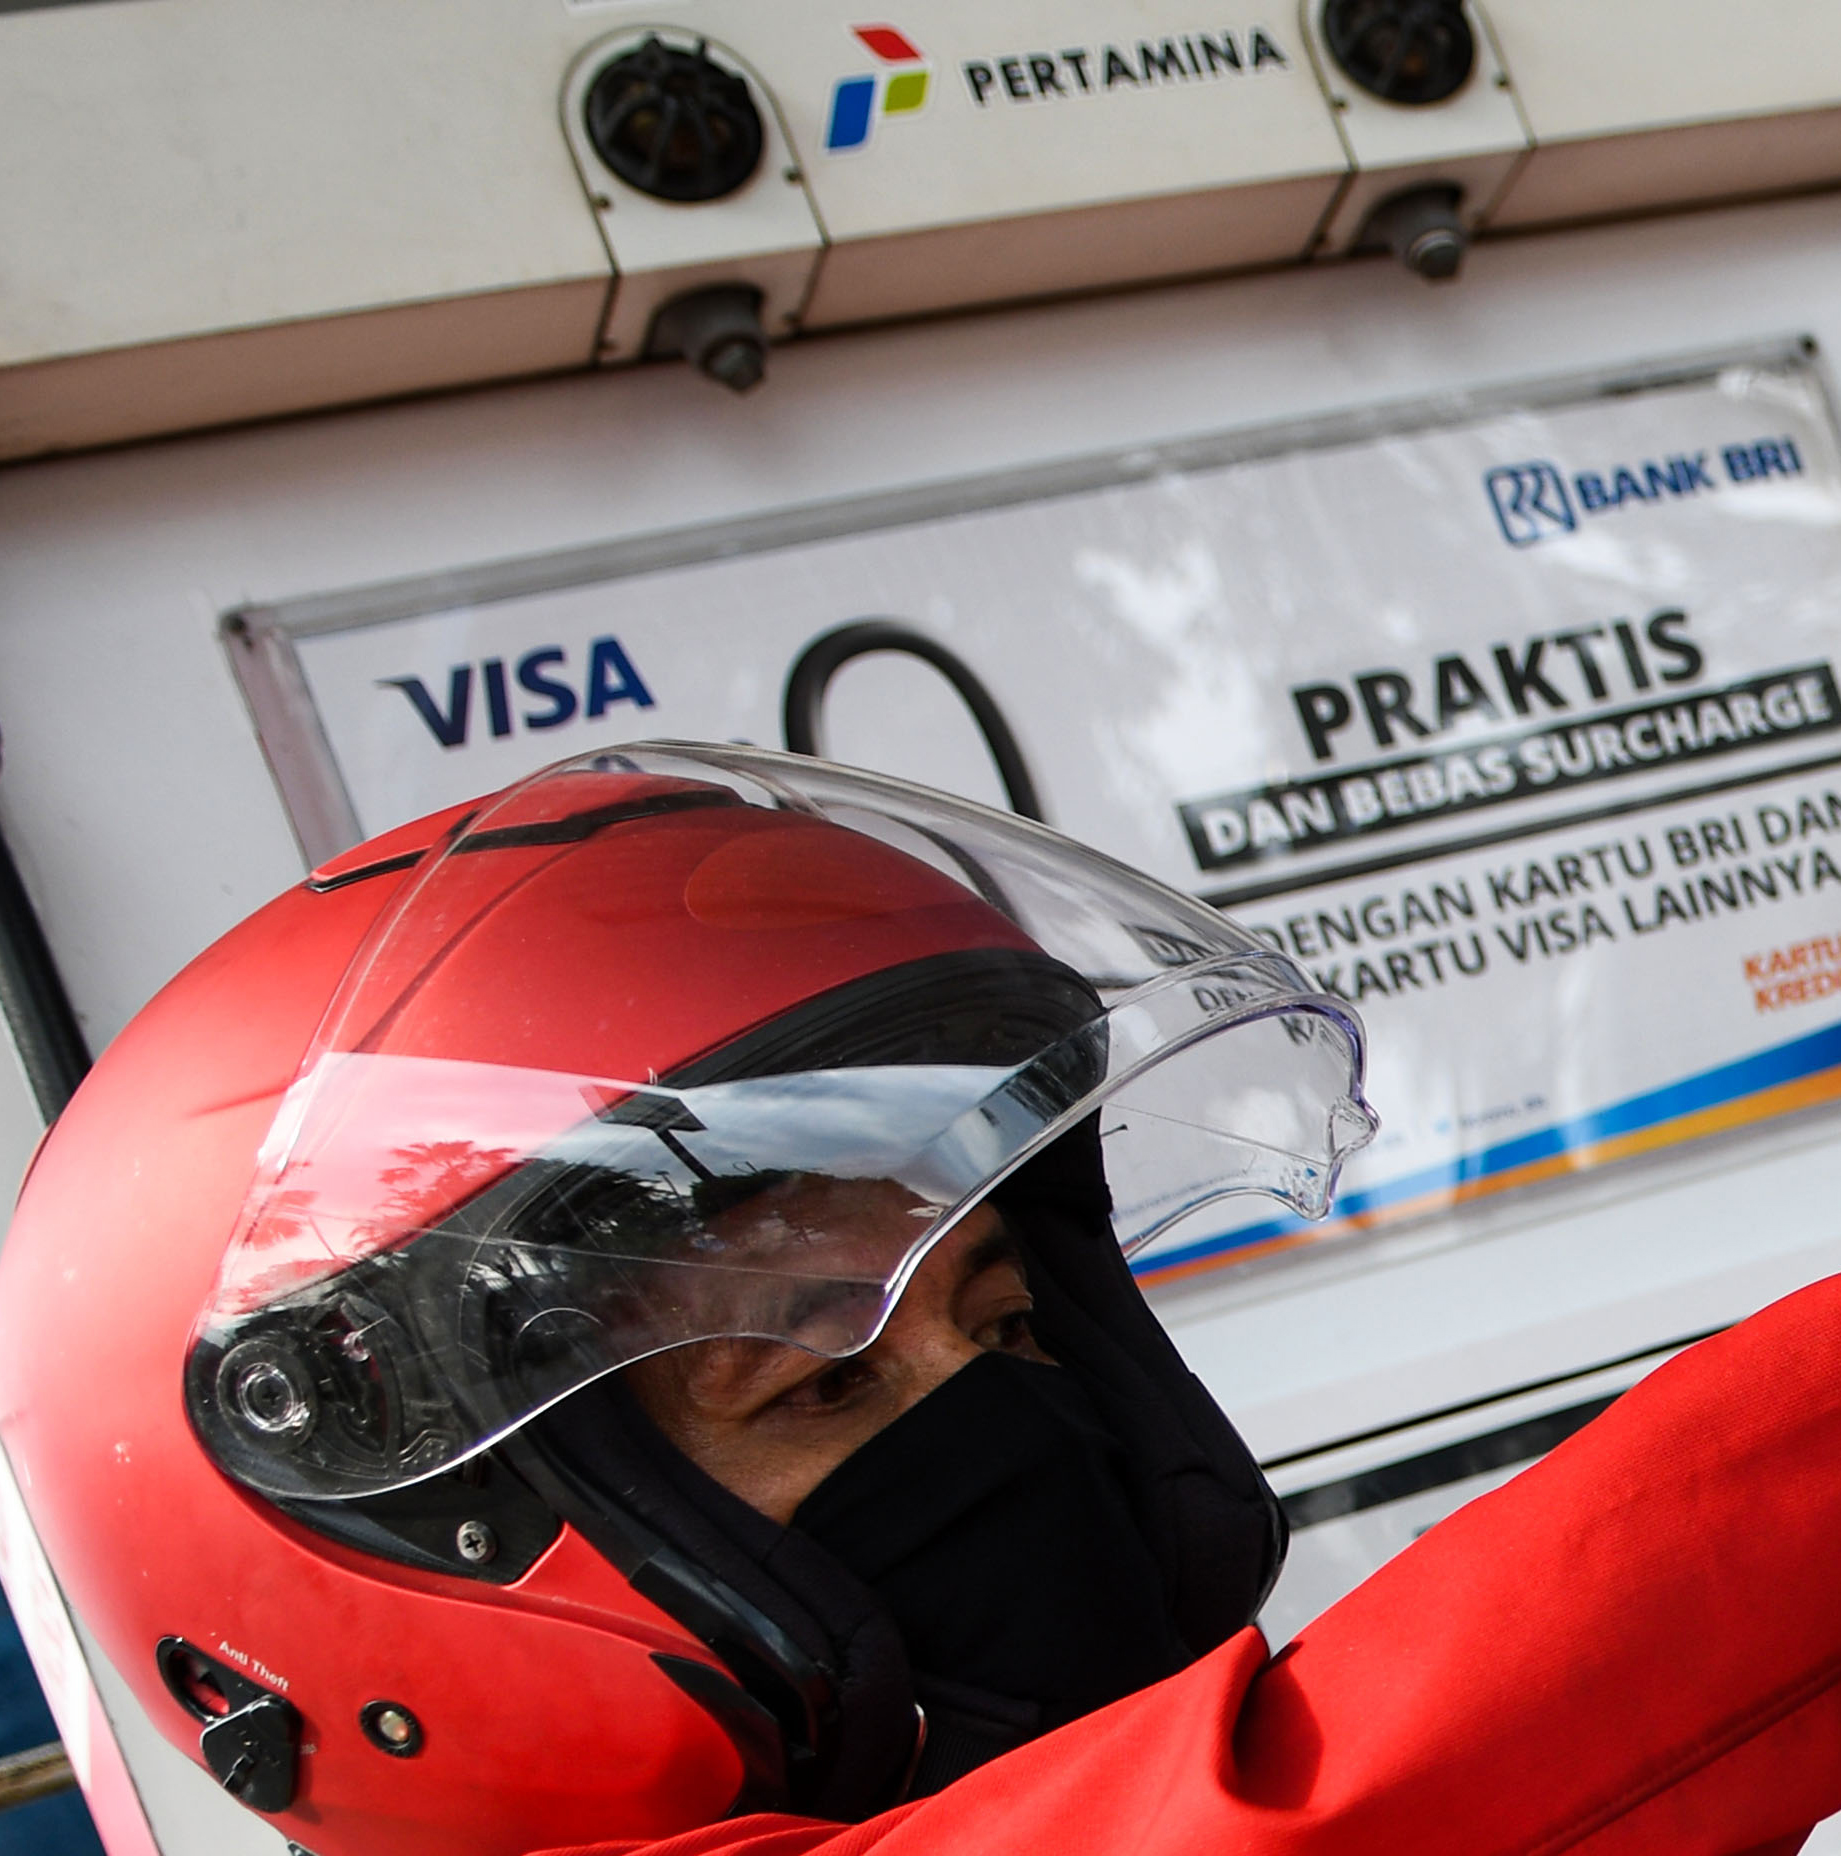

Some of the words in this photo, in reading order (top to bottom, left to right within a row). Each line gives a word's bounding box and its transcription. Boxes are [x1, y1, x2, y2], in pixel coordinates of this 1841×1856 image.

[963, 26, 1291, 108] PERTAMINA
[1573, 448, 1714, 514] BANK
[1722, 437, 1805, 482] BRI
[377, 634, 656, 750] VISA
[1291, 607, 1706, 762] PRAKTIS
[1202, 785, 1336, 857] DAN
[1344, 750, 1517, 829] BEBAS
[1526, 676, 1836, 785] SURCHARGE
[1253, 878, 1478, 962] DENGAN
[1487, 836, 1656, 912] KARTU
[1665, 816, 1750, 872] BRI
[1318, 934, 1488, 1003] KARTU
[1499, 904, 1617, 966] VISA
[218, 1639, 248, 1667] Anti
[250, 1660, 291, 1693] Theft
